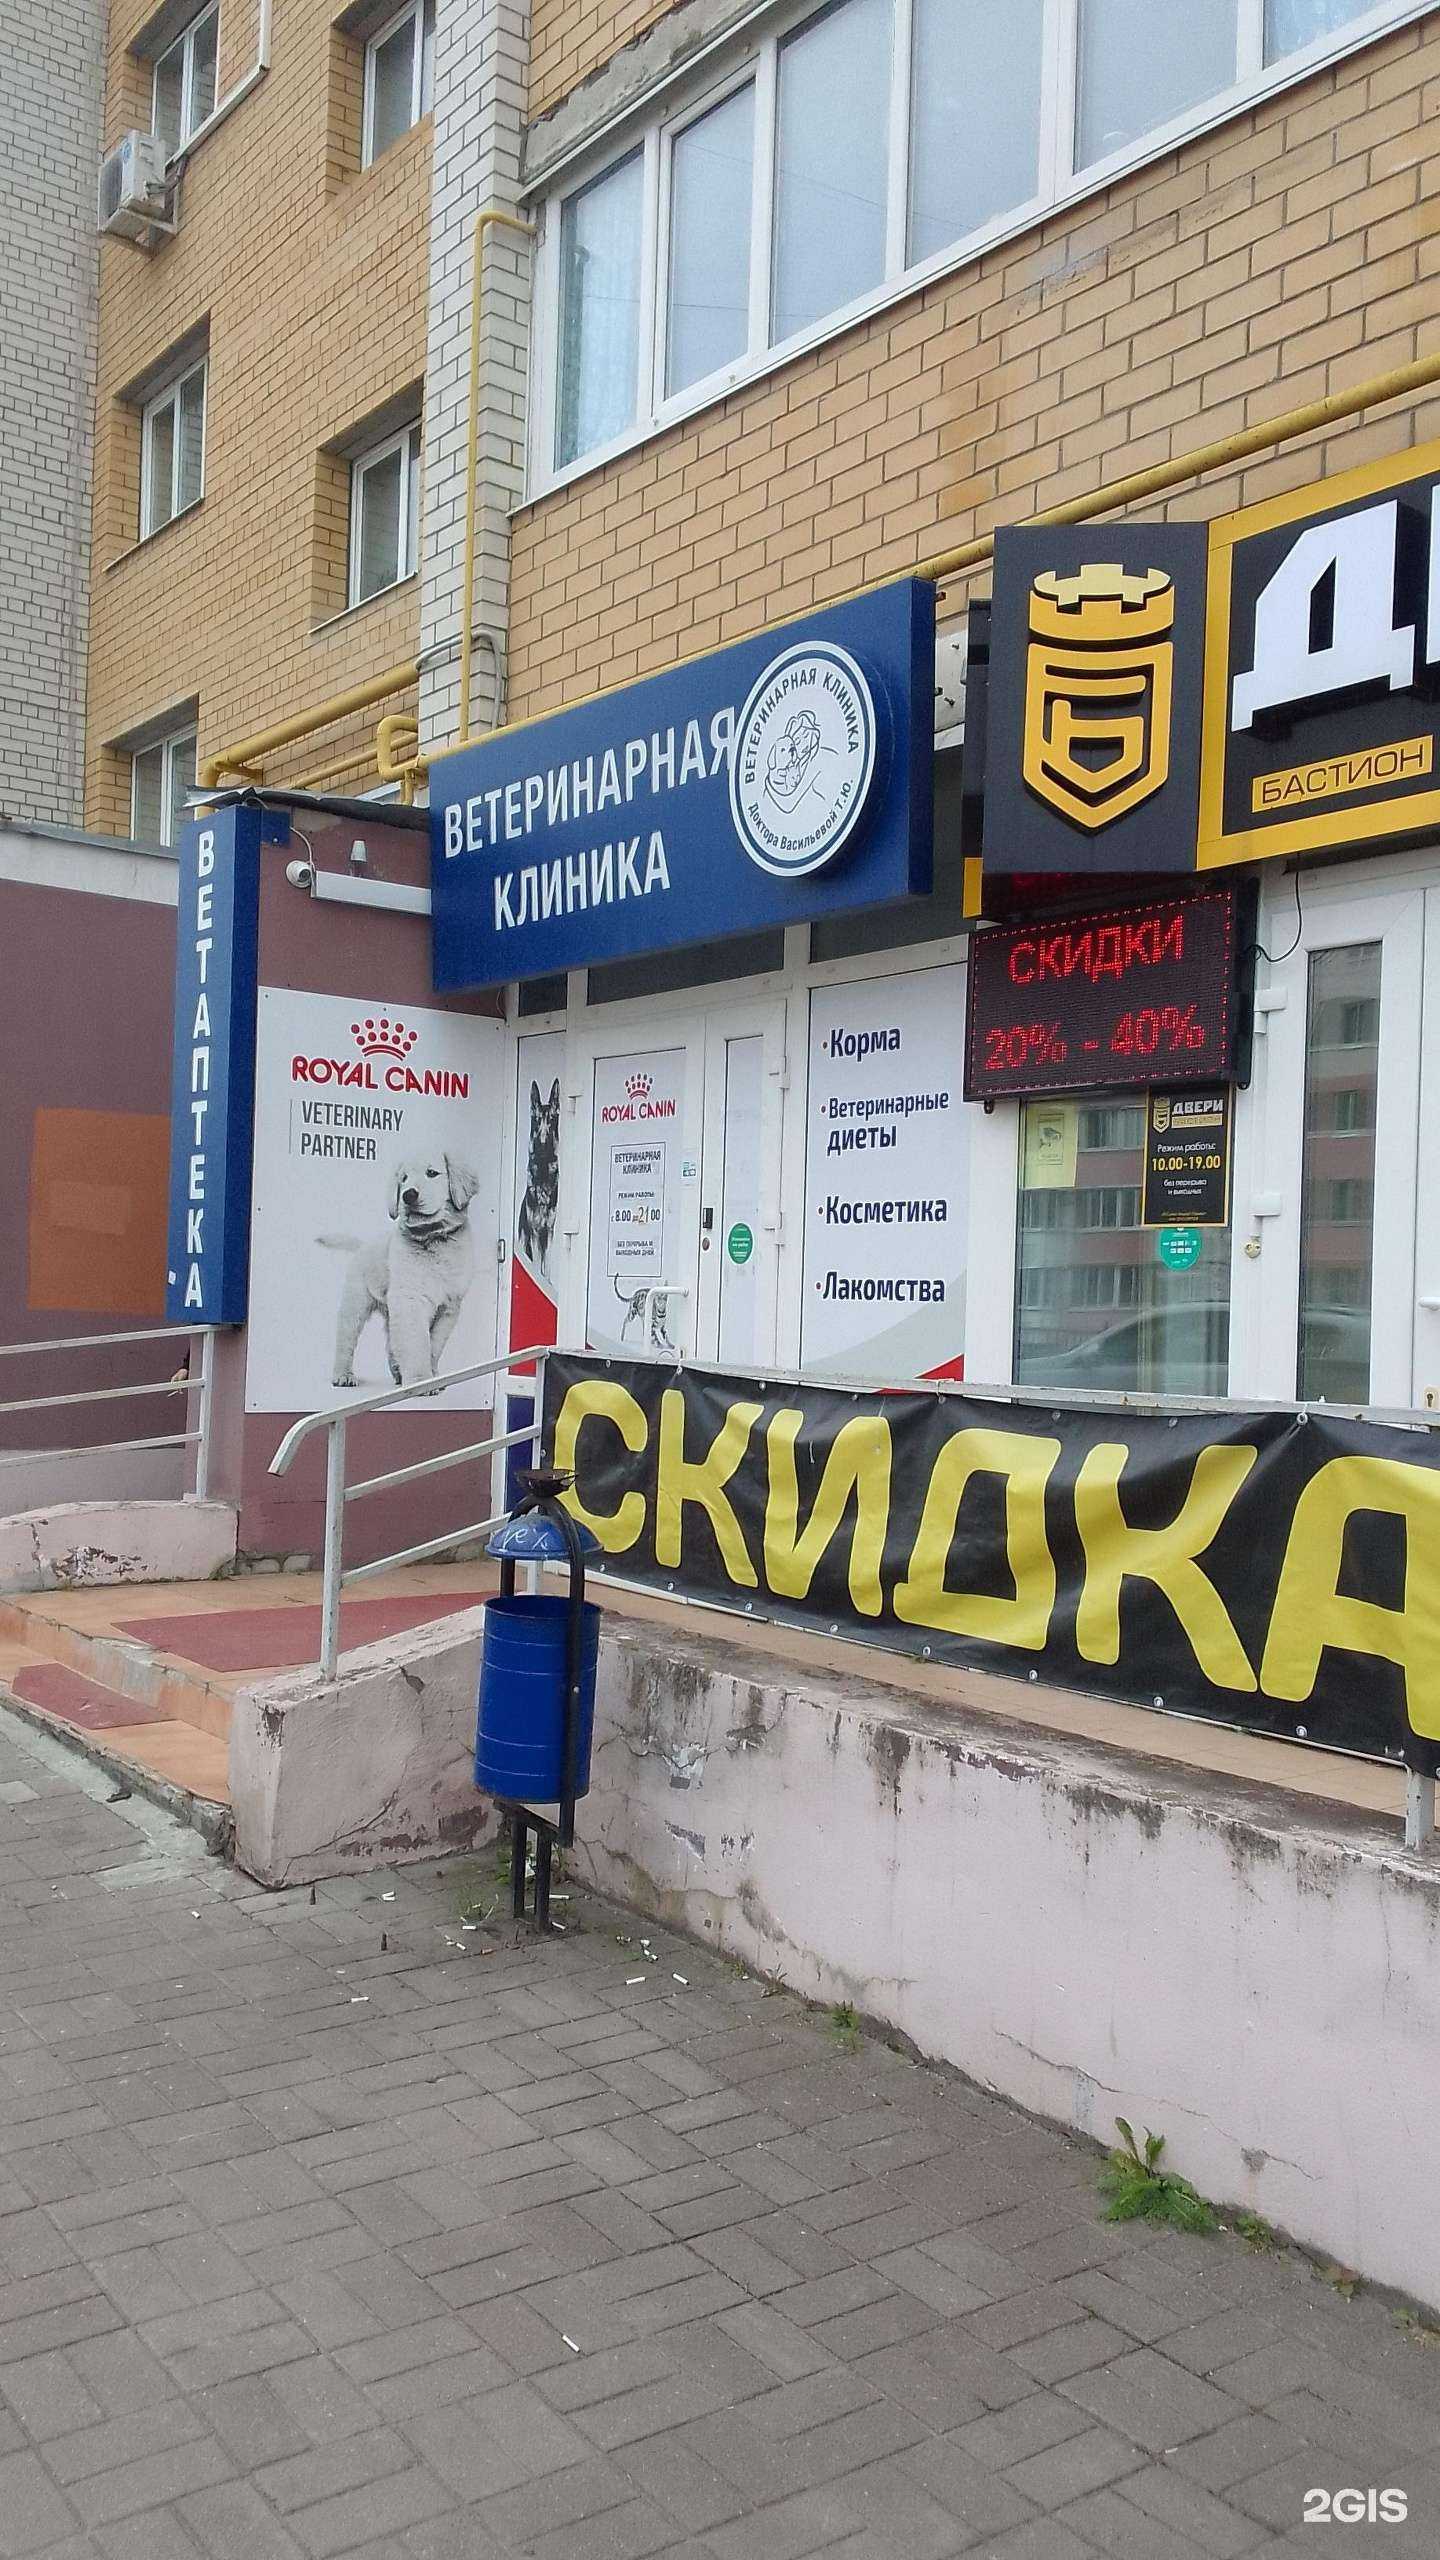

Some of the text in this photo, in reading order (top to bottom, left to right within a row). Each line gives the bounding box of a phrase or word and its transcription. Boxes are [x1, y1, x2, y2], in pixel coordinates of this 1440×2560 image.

[1231, 483, 1440, 732] Д
[745, 667, 860, 784] ВЕТЕРИНАРНАЯ КЛИНИКА
[444, 706, 735, 859] ВЕТЕРИНАРНАЯ
[1261, 743, 1425, 804] БАСТИОН
[747, 802, 780, 848] Доктора
[780, 810, 839, 851] Васильевой
[494, 830, 671, 931] КЛИНИКА
[1008, 914, 1185, 985] СКИДКИ
[830, 1028, 901, 1062] Корма
[984, 1022, 1068, 1071] 20%
[1111, 1003, 1205, 1056] 40%
[185, 830, 215, 1309] ВЕТАПТЕКА
[292, 1055, 469, 1099] ROYAL CANIN
[302, 1100, 404, 1131] VETERINARY
[602, 1099, 676, 1123] ROYAL CANIN
[828, 1092, 949, 1121] Ветеринарные
[1172, 1099, 1224, 1115] ДВЕРИ
[301, 1133, 376, 1160] PARTNER
[614, 1150, 661, 1163] ВЕТЕРИНАРНАЯ
[826, 1125, 897, 1156] диеты
[1152, 1155, 1221, 1171] 10.00-19.00
[826, 1196, 947, 1224] Косметика
[823, 1271, 946, 1302] Лакомства
[553, 1380, 1440, 1741] СКИДКА
